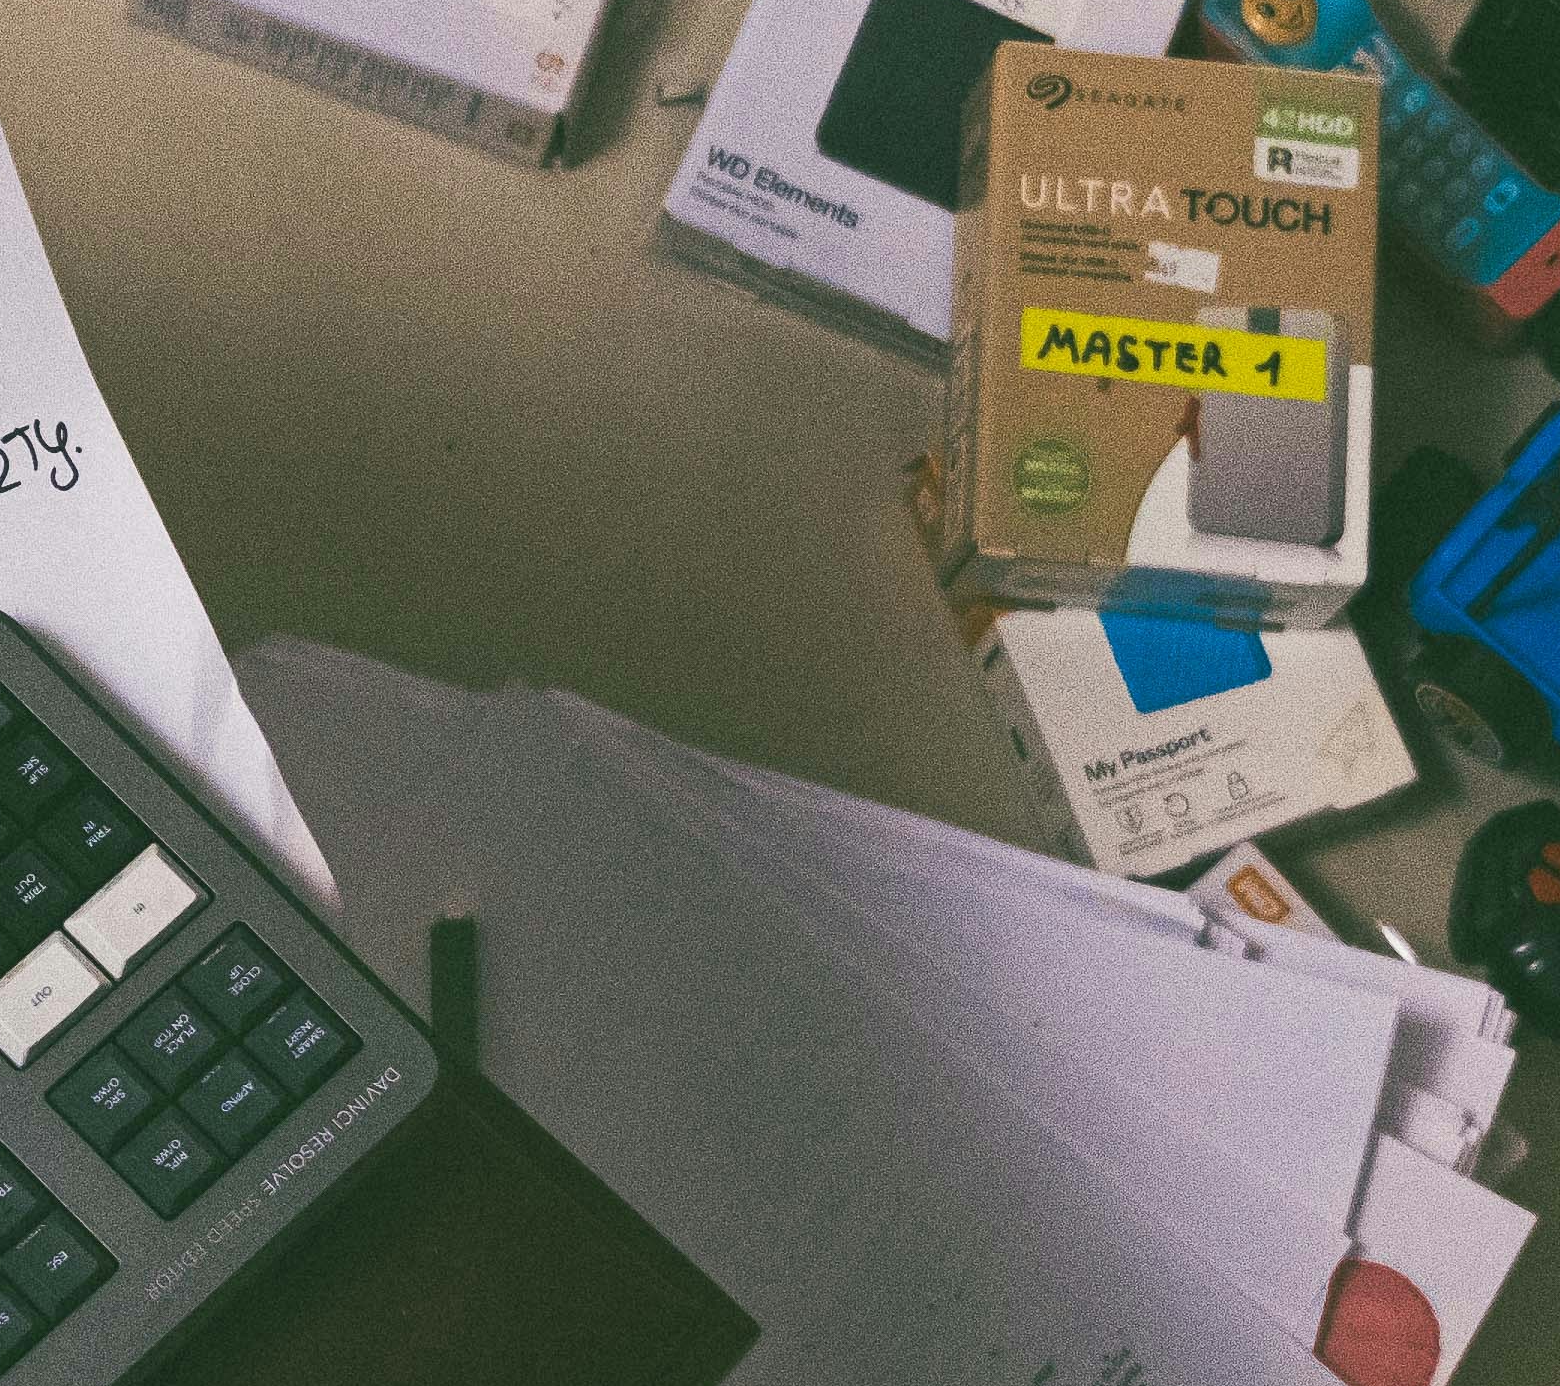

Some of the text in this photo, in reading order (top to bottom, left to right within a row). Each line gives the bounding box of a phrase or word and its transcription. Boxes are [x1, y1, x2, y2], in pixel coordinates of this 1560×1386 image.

[1074, 85, 1187, 112] SEAGATE
[704, 145, 865, 230] WD Elements
[1019, 174, 1333, 236] ULTRA TOUCH
[1038, 320, 1281, 386] MASTER 1
[16, 753, 40, 776] SRC
[1082, 755, 1118, 783] My
[1118, 723, 1213, 770] Passport
[23, 761, 49, 785] SLIP
[81, 818, 97, 834] IN
[84, 822, 111, 848] TRIM
[12, 871, 37, 895] OUT
[19, 879, 47, 906] TRIM
[130, 900, 146, 916] IN
[225, 962, 245, 982] UP
[226, 962, 262, 998] CLOSE
[28, 984, 53, 1008] OUT
[150, 1011, 190, 1049] ON TOP
[161, 1022, 197, 1057] PLACE
[281, 1017, 314, 1049] INSRT
[288, 1024, 326, 1061] SMART
[101, 1086, 126, 1111] SRC
[218, 1078, 255, 1115] APPND
[163, 1149, 189, 1174] RIPL
[142, 1063, 401, 1301] DAVINCI RESOLVE SPEED EDITOR
[44, 1248, 69, 1272] ESC
